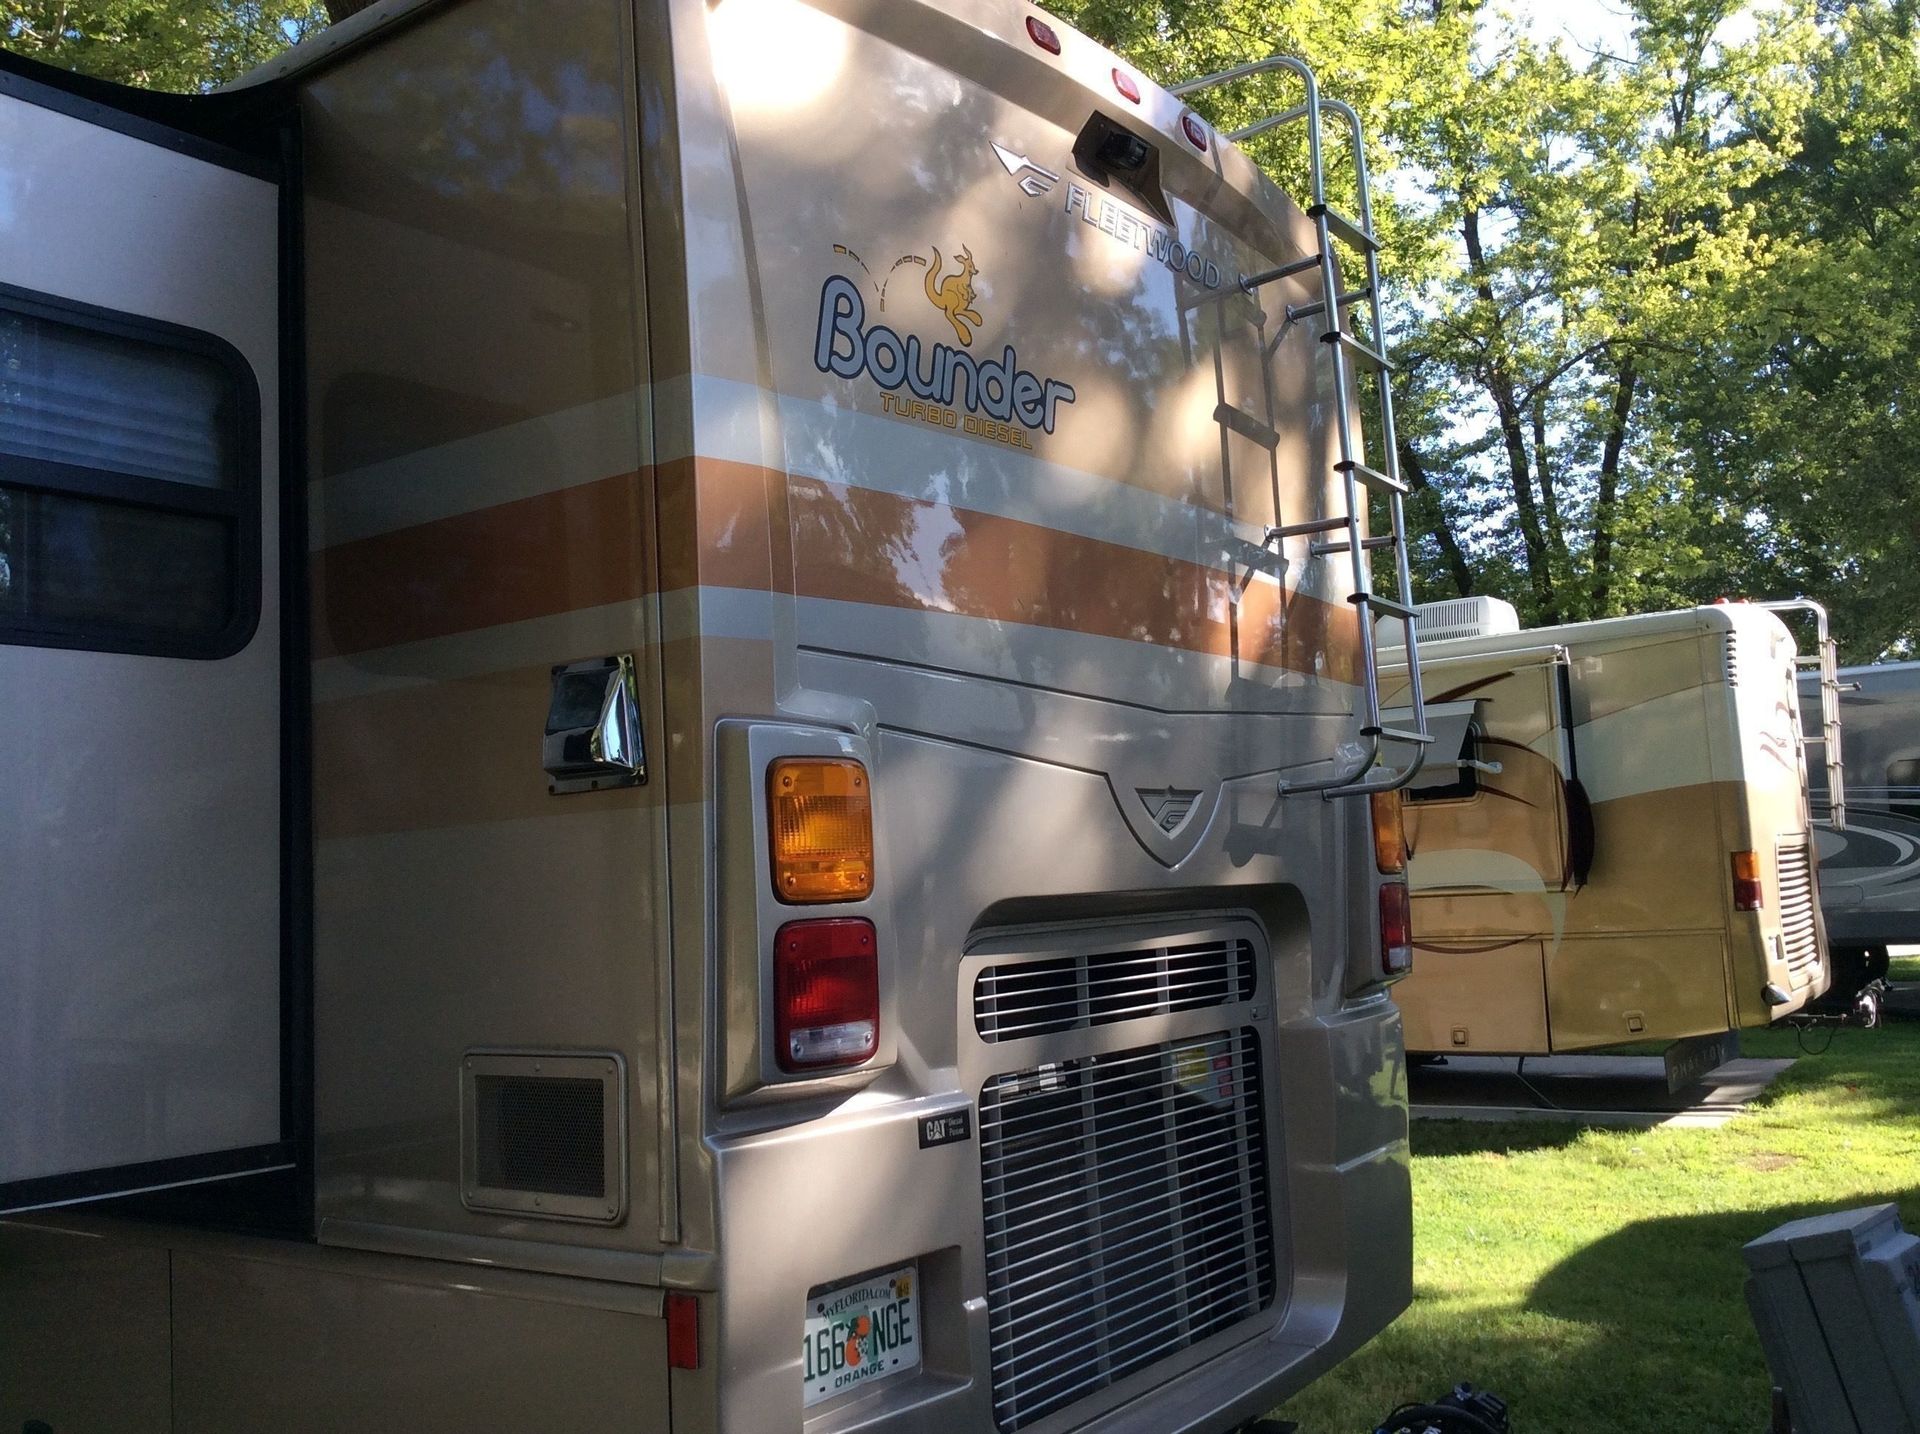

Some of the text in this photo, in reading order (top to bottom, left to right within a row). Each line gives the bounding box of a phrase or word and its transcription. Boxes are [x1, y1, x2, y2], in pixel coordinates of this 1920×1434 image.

[1065, 182, 1220, 288] FLEETWOOD
[814, 275, 1076, 435] Bounder
[880, 391, 1033, 450] TURBO DIESEL
[926, 1119, 946, 1141] CAT
[803, 1298, 912, 1383] 166 NGE
[835, 1360, 885, 1389] ORANGE
